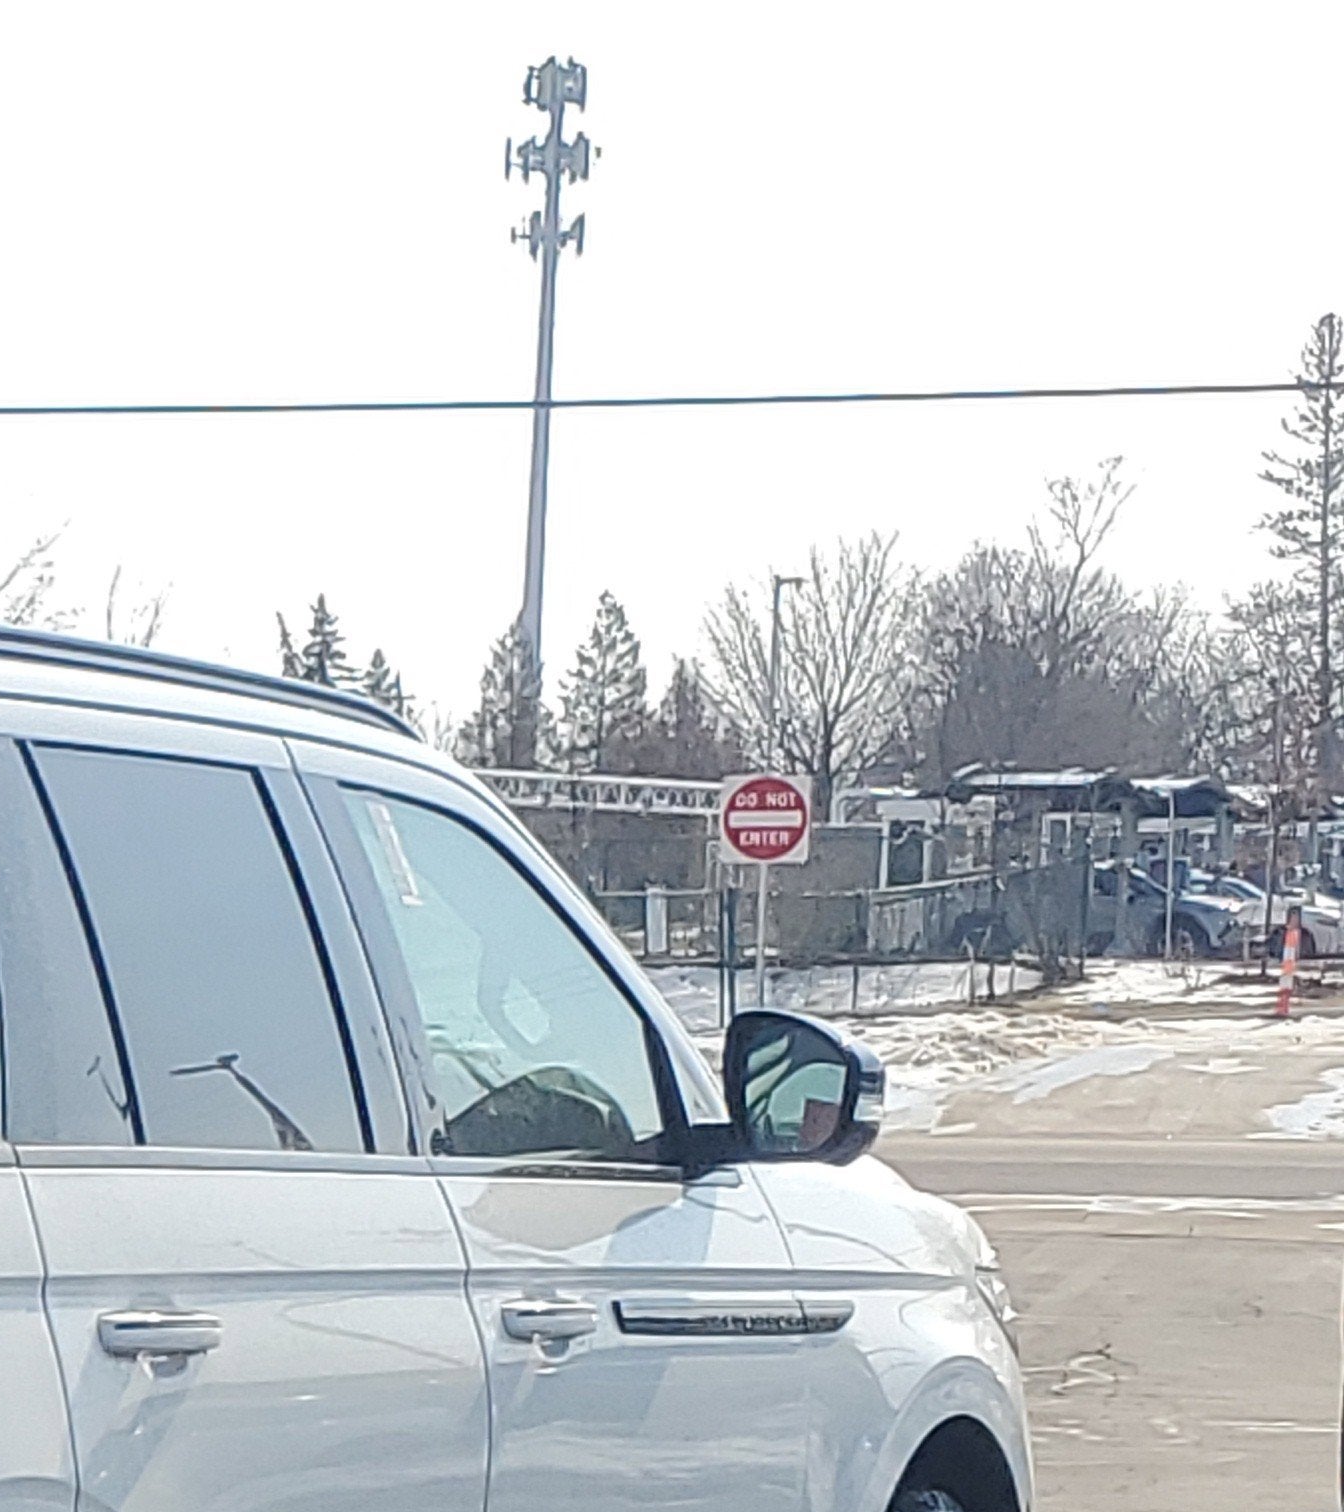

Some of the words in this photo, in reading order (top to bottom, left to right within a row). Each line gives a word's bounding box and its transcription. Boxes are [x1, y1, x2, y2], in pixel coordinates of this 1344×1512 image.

[734, 791, 758, 808] DO
[766, 791, 797, 808] NOT
[738, 830, 790, 847] ENTER
